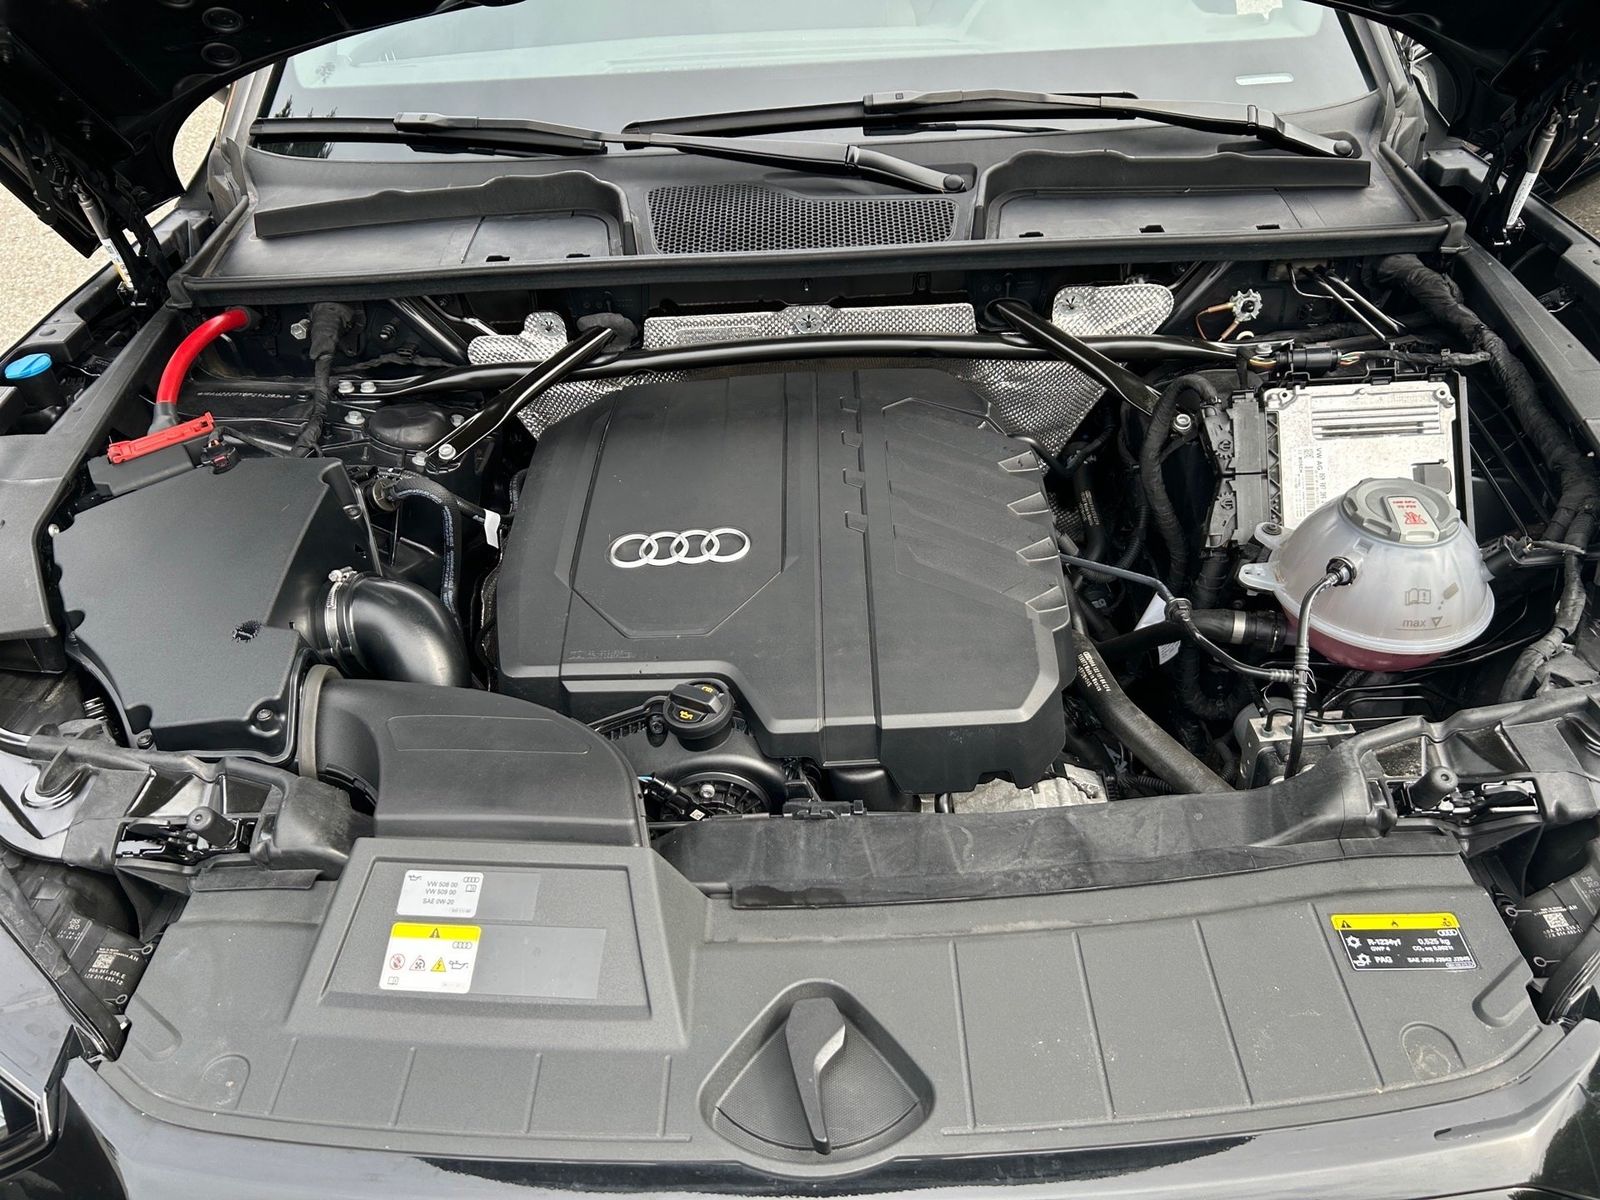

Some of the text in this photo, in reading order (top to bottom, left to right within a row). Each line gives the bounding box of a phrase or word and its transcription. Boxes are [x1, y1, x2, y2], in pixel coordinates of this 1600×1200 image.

[1316, 447, 1323, 459] VW
[1316, 460, 1324, 471] AG
[1402, 619, 1426, 627] max
[1367, 938, 1401, 946] R-1234yf
[1440, 938, 1451, 946] kg
[128, 954, 139, 962] AH
[1374, 956, 1394, 964] PAG
